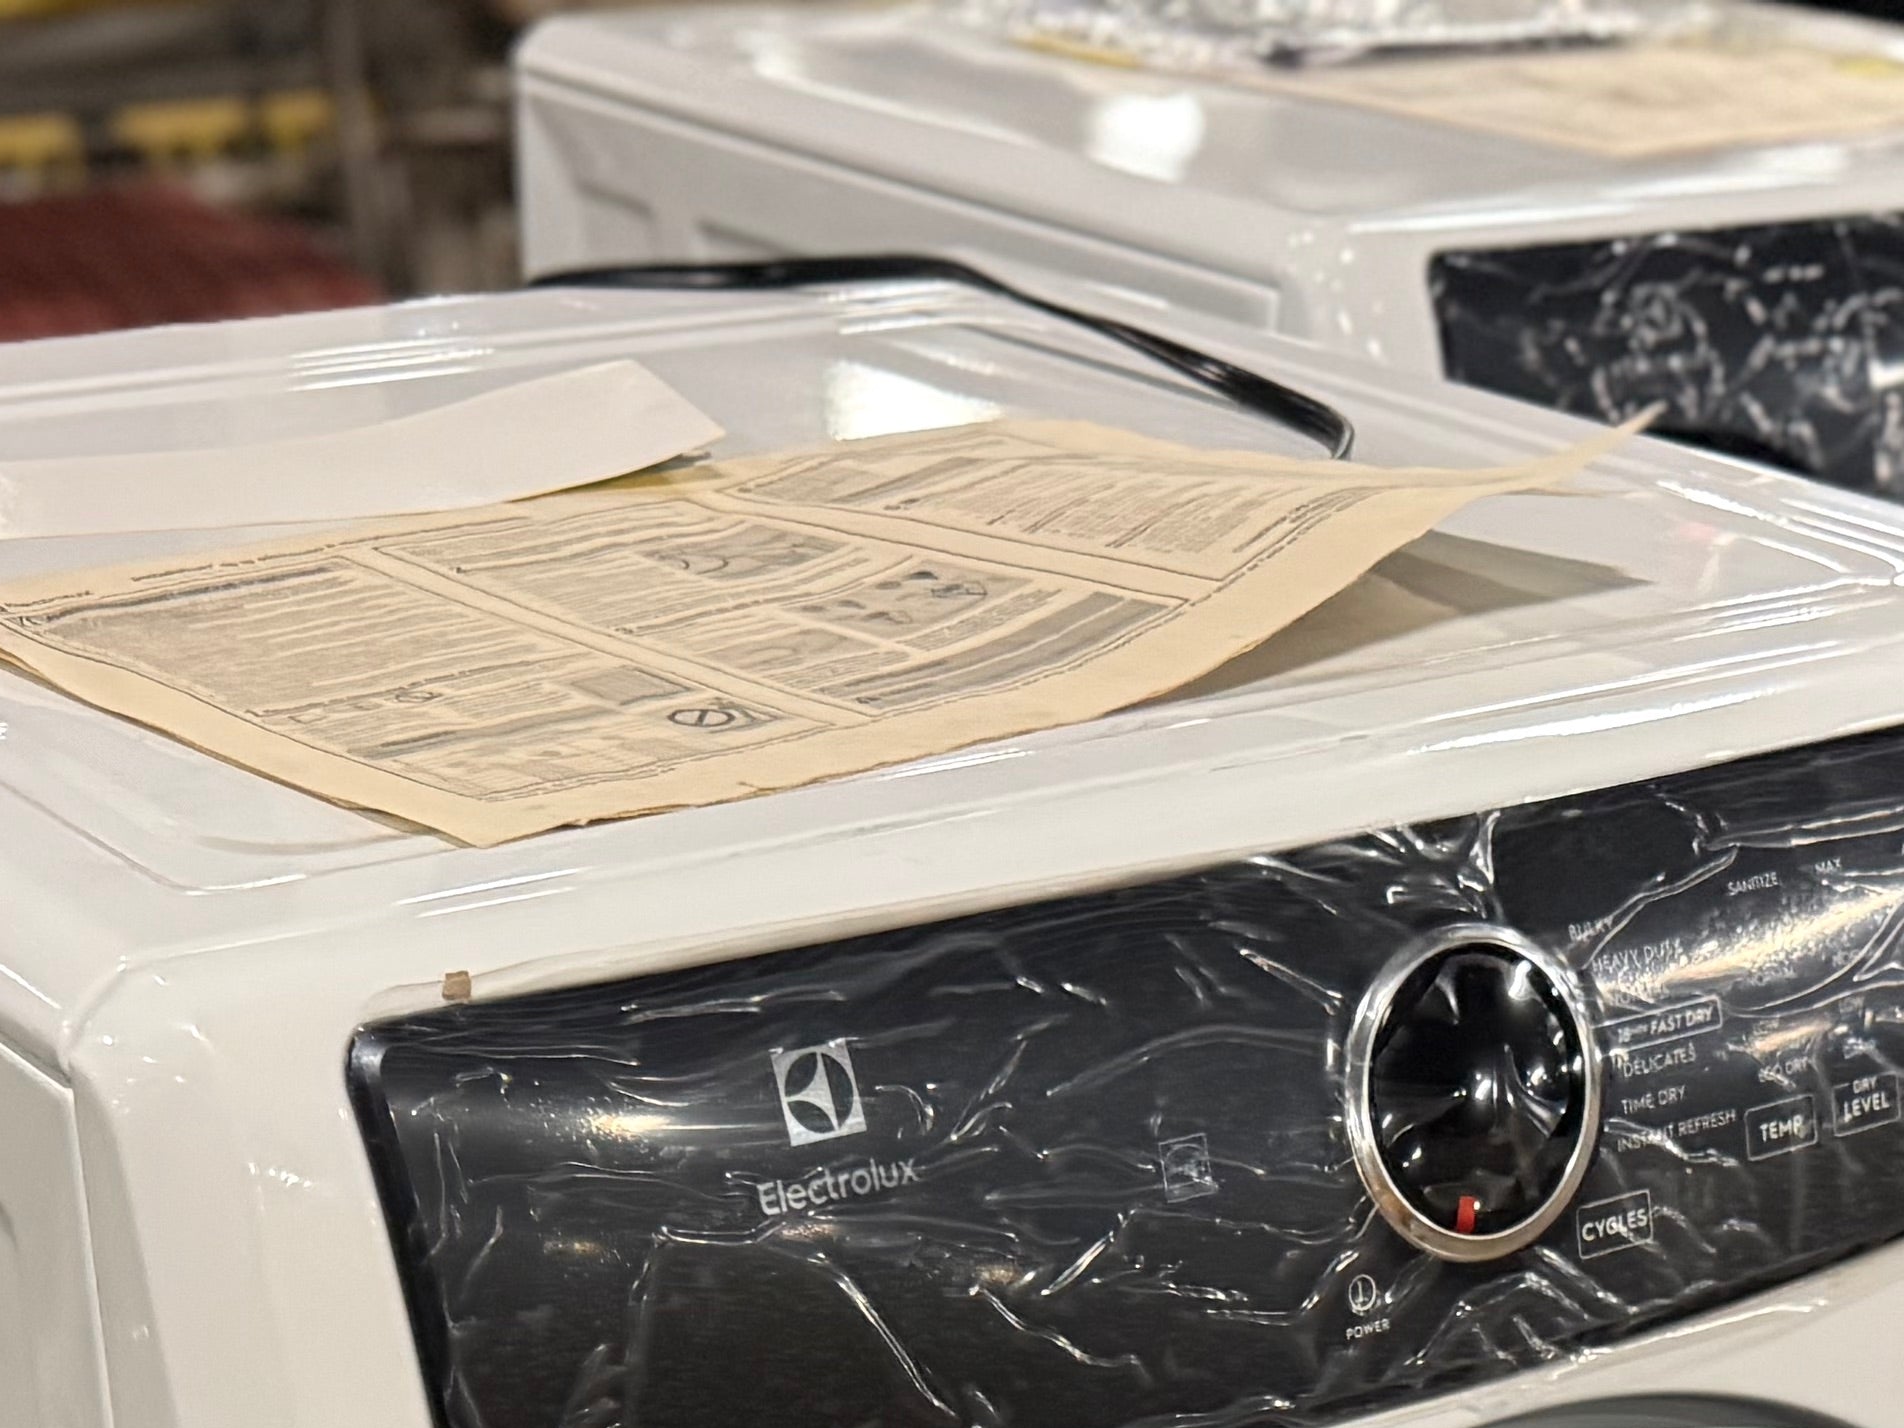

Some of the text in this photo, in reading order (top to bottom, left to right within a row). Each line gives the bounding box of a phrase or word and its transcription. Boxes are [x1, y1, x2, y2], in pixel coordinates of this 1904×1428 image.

[1815, 857, 1842, 876] MAX
[1726, 871, 1779, 897] SANITIZE
[1649, 1014, 1683, 1035] FAST
[1685, 1006, 1714, 1026] DRY
[1622, 1044, 1697, 1079] DELICATES
[1852, 1076, 1878, 1095] DRY
[1621, 1085, 1686, 1115] TIME DRY
[1843, 1091, 1891, 1123] LEVEL
[1677, 1109, 1737, 1137] REFRESH
[1759, 1114, 1806, 1142] TEMP
[755, 1156, 922, 1216] Electrolux
[1581, 1207, 1649, 1242] CYCLES
[1345, 1317, 1391, 1341] POWER
